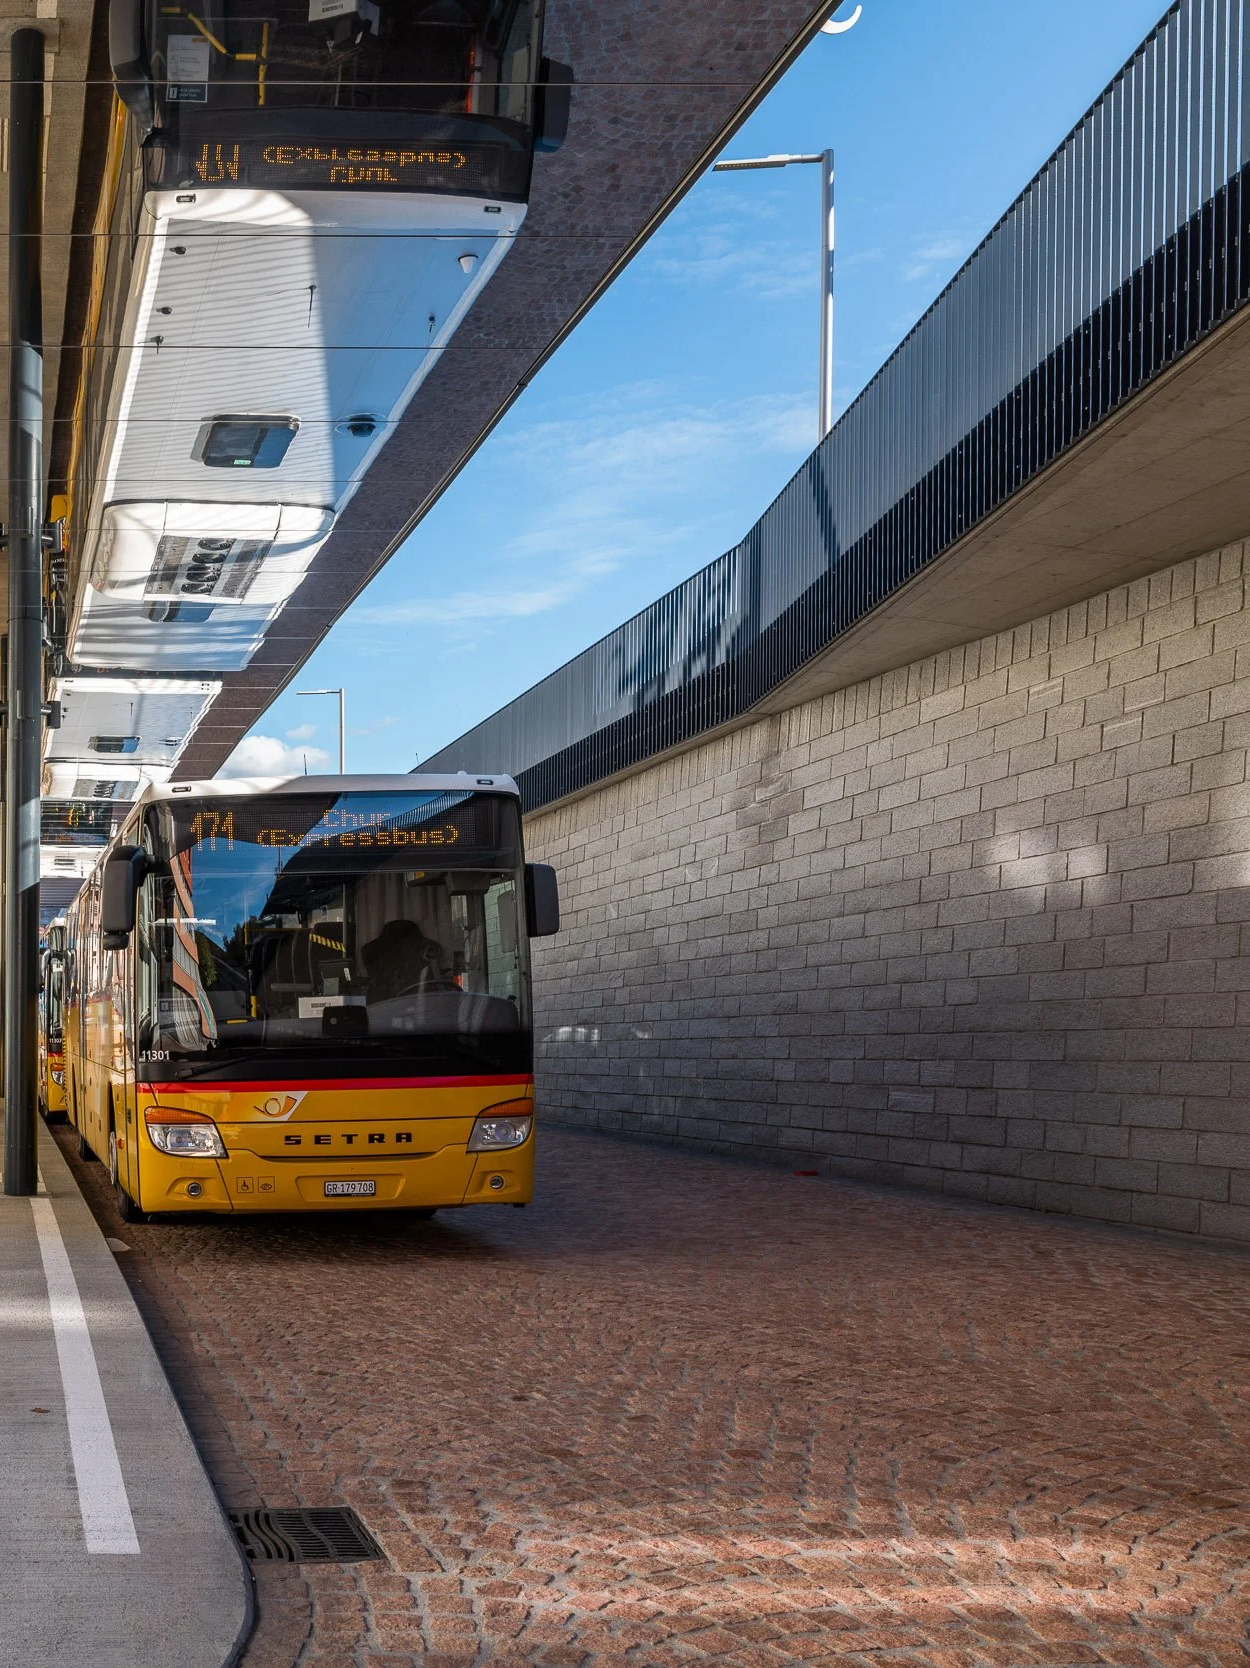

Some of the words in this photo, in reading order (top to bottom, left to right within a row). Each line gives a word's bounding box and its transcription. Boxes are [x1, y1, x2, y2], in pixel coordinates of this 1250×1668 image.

[190, 811, 234, 851] 171
[256, 824, 460, 848] (Expressbus)
[141, 1050, 170, 1061] 11301
[284, 1132, 414, 1146] SETRA
